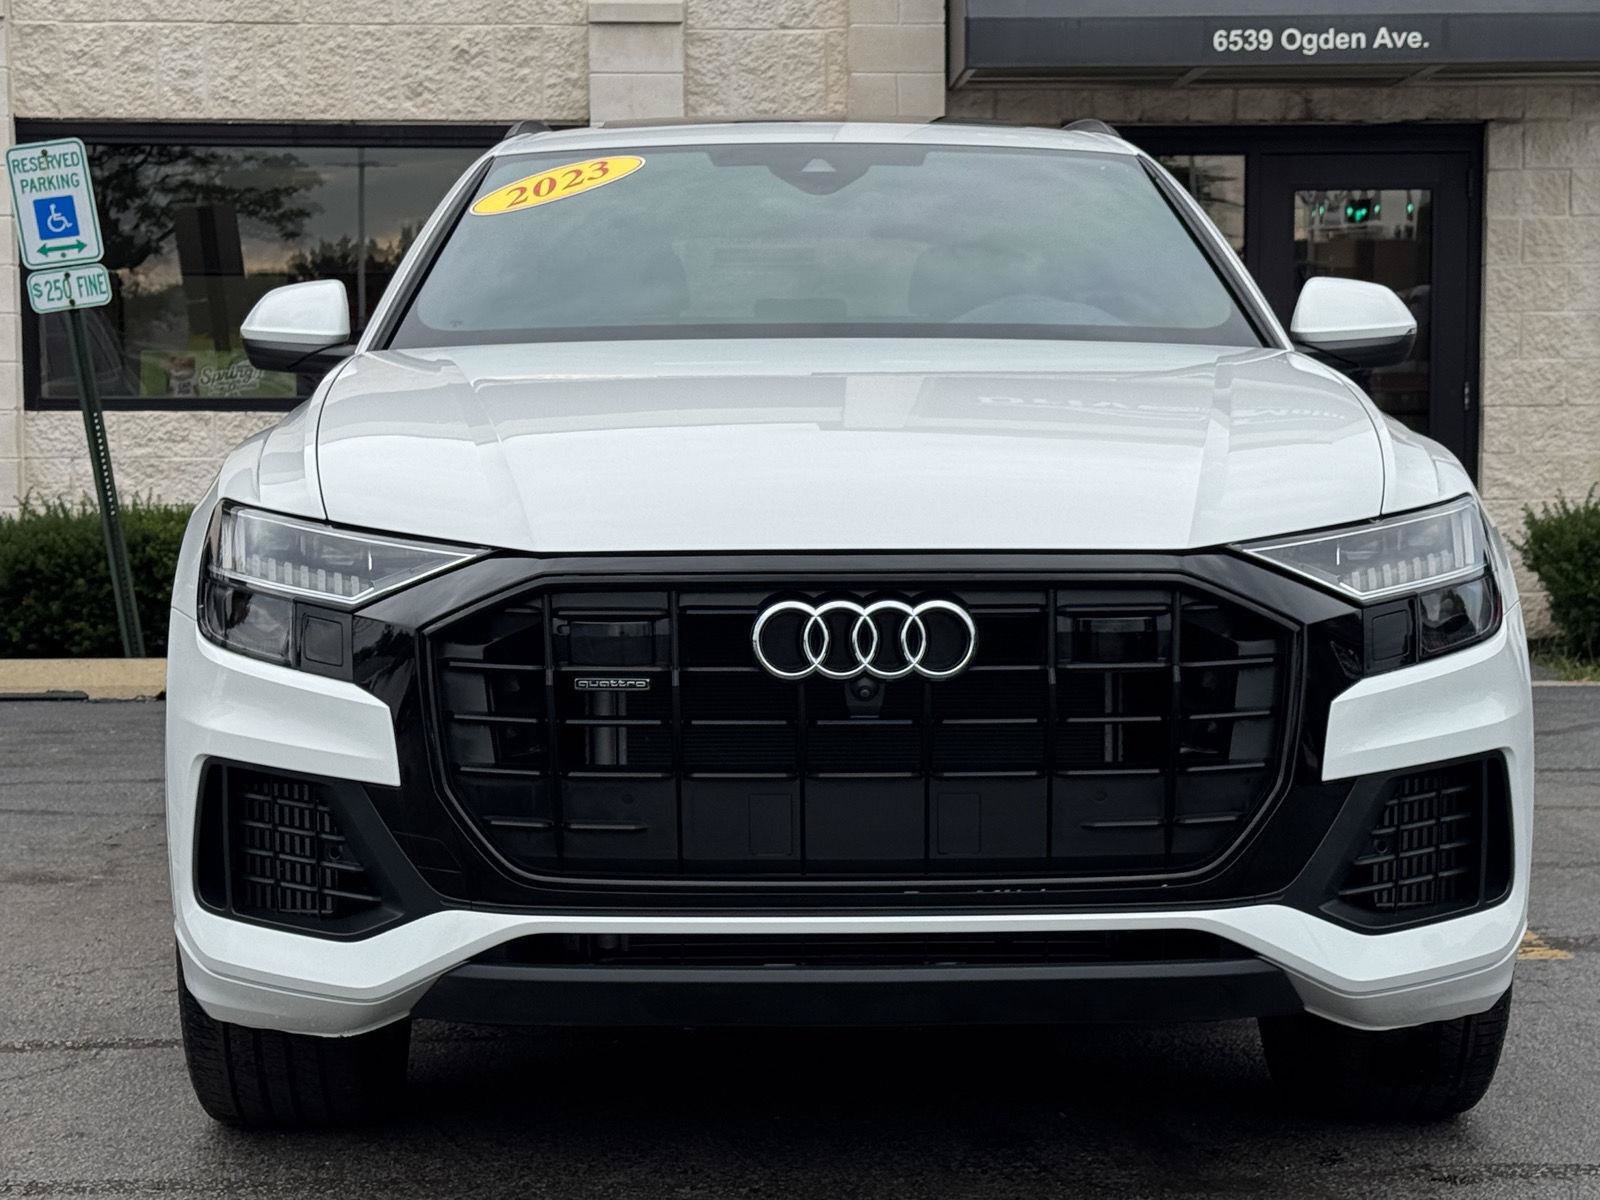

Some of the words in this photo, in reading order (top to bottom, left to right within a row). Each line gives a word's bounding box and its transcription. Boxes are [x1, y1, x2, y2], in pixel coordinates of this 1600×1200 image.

[1212, 29, 1274, 51] 6539
[1280, 27, 1367, 55] Ogden
[1372, 26, 1430, 49] Ave.
[11, 151, 80, 174] RESERVED
[20, 172, 80, 194] PARKING
[506, 160, 609, 208] 2023
[32, 278, 73, 302] $250
[76, 273, 107, 299] FINE
[577, 680, 646, 688] quattro
